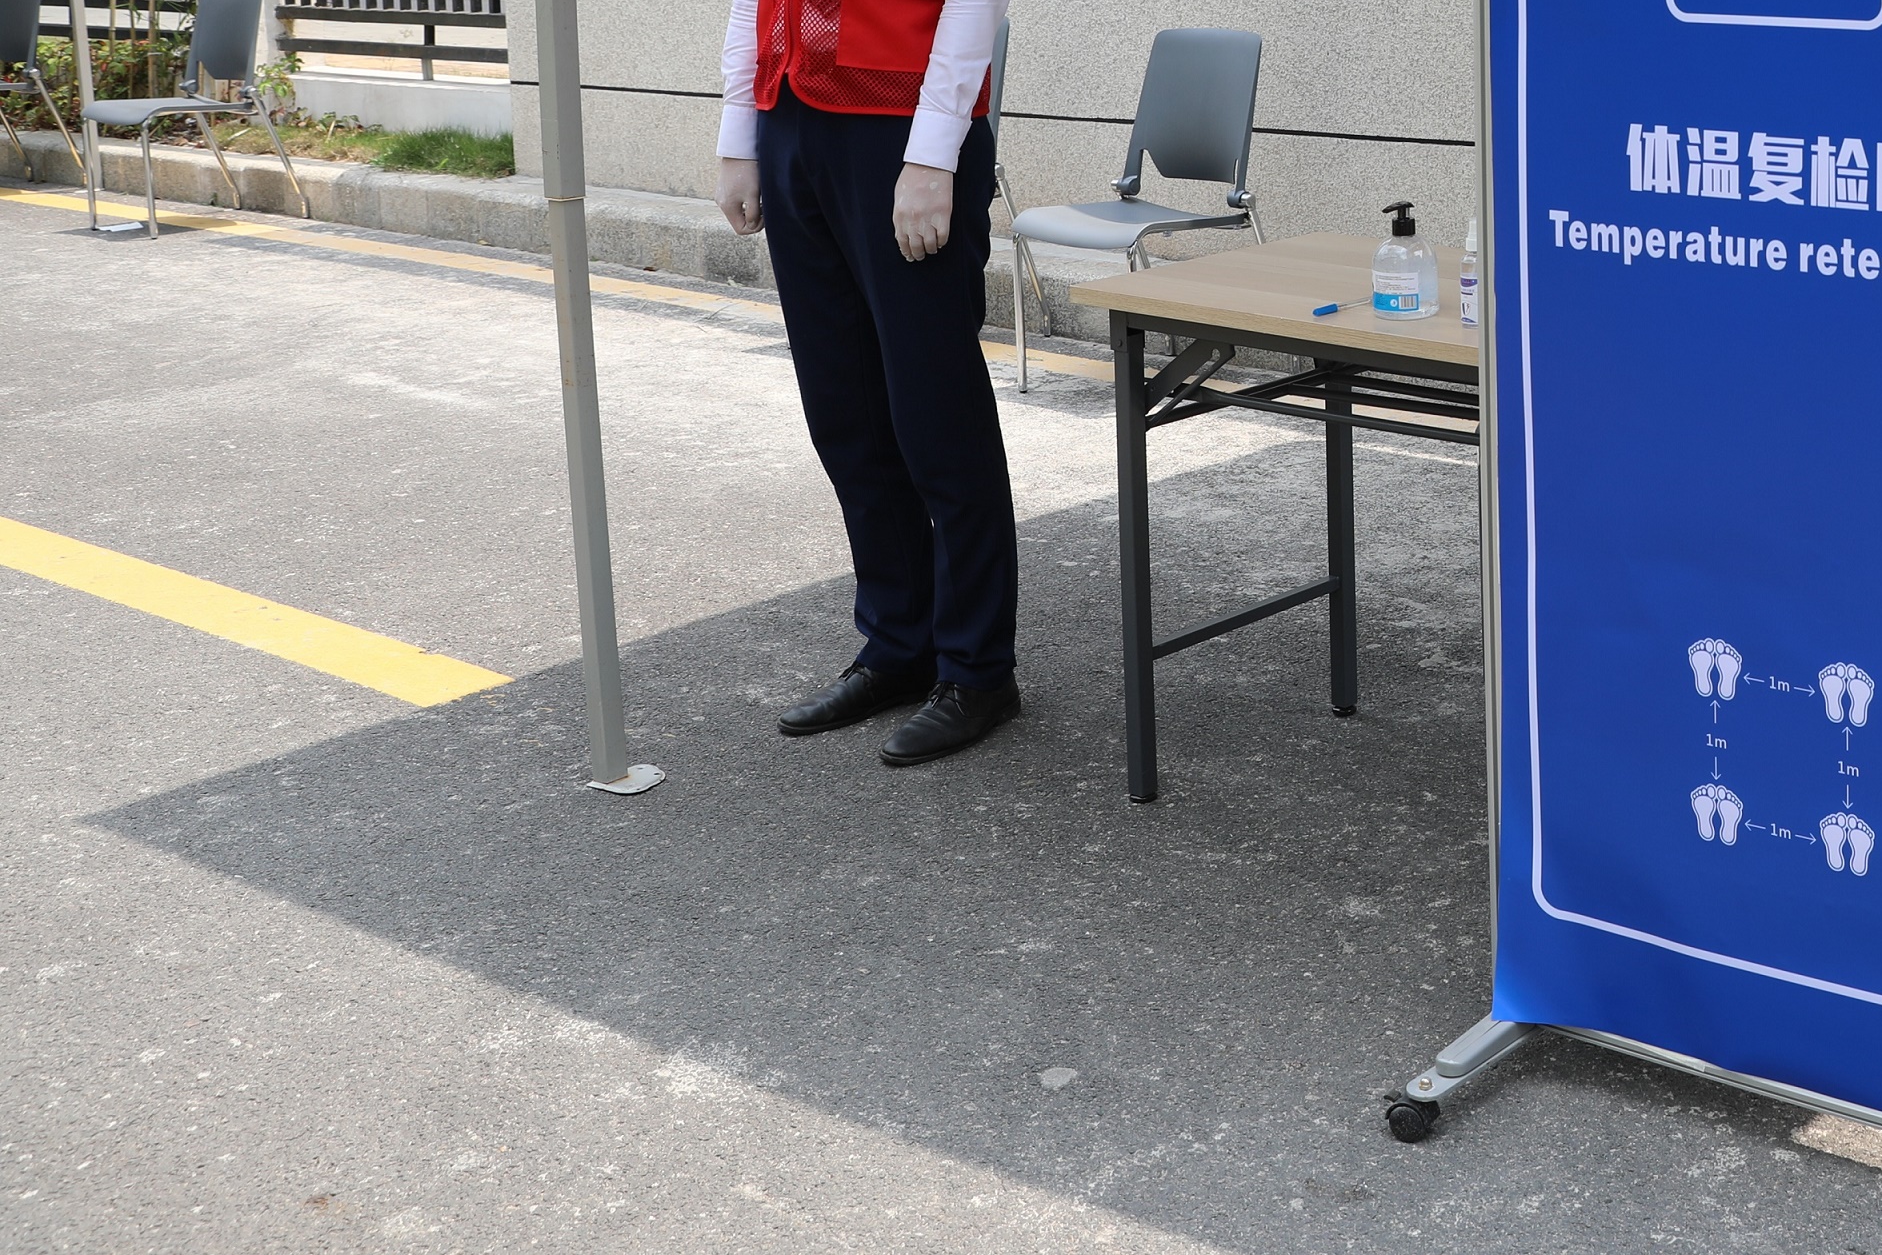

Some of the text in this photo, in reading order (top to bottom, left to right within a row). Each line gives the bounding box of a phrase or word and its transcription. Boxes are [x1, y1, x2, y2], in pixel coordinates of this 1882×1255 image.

[1548, 208, 1789, 272] Temperature
[1768, 675, 1791, 693] 1m
[1705, 732, 1728, 750] 1m
[1837, 760, 1860, 778] 1m
[1769, 822, 1793, 840] 1m
